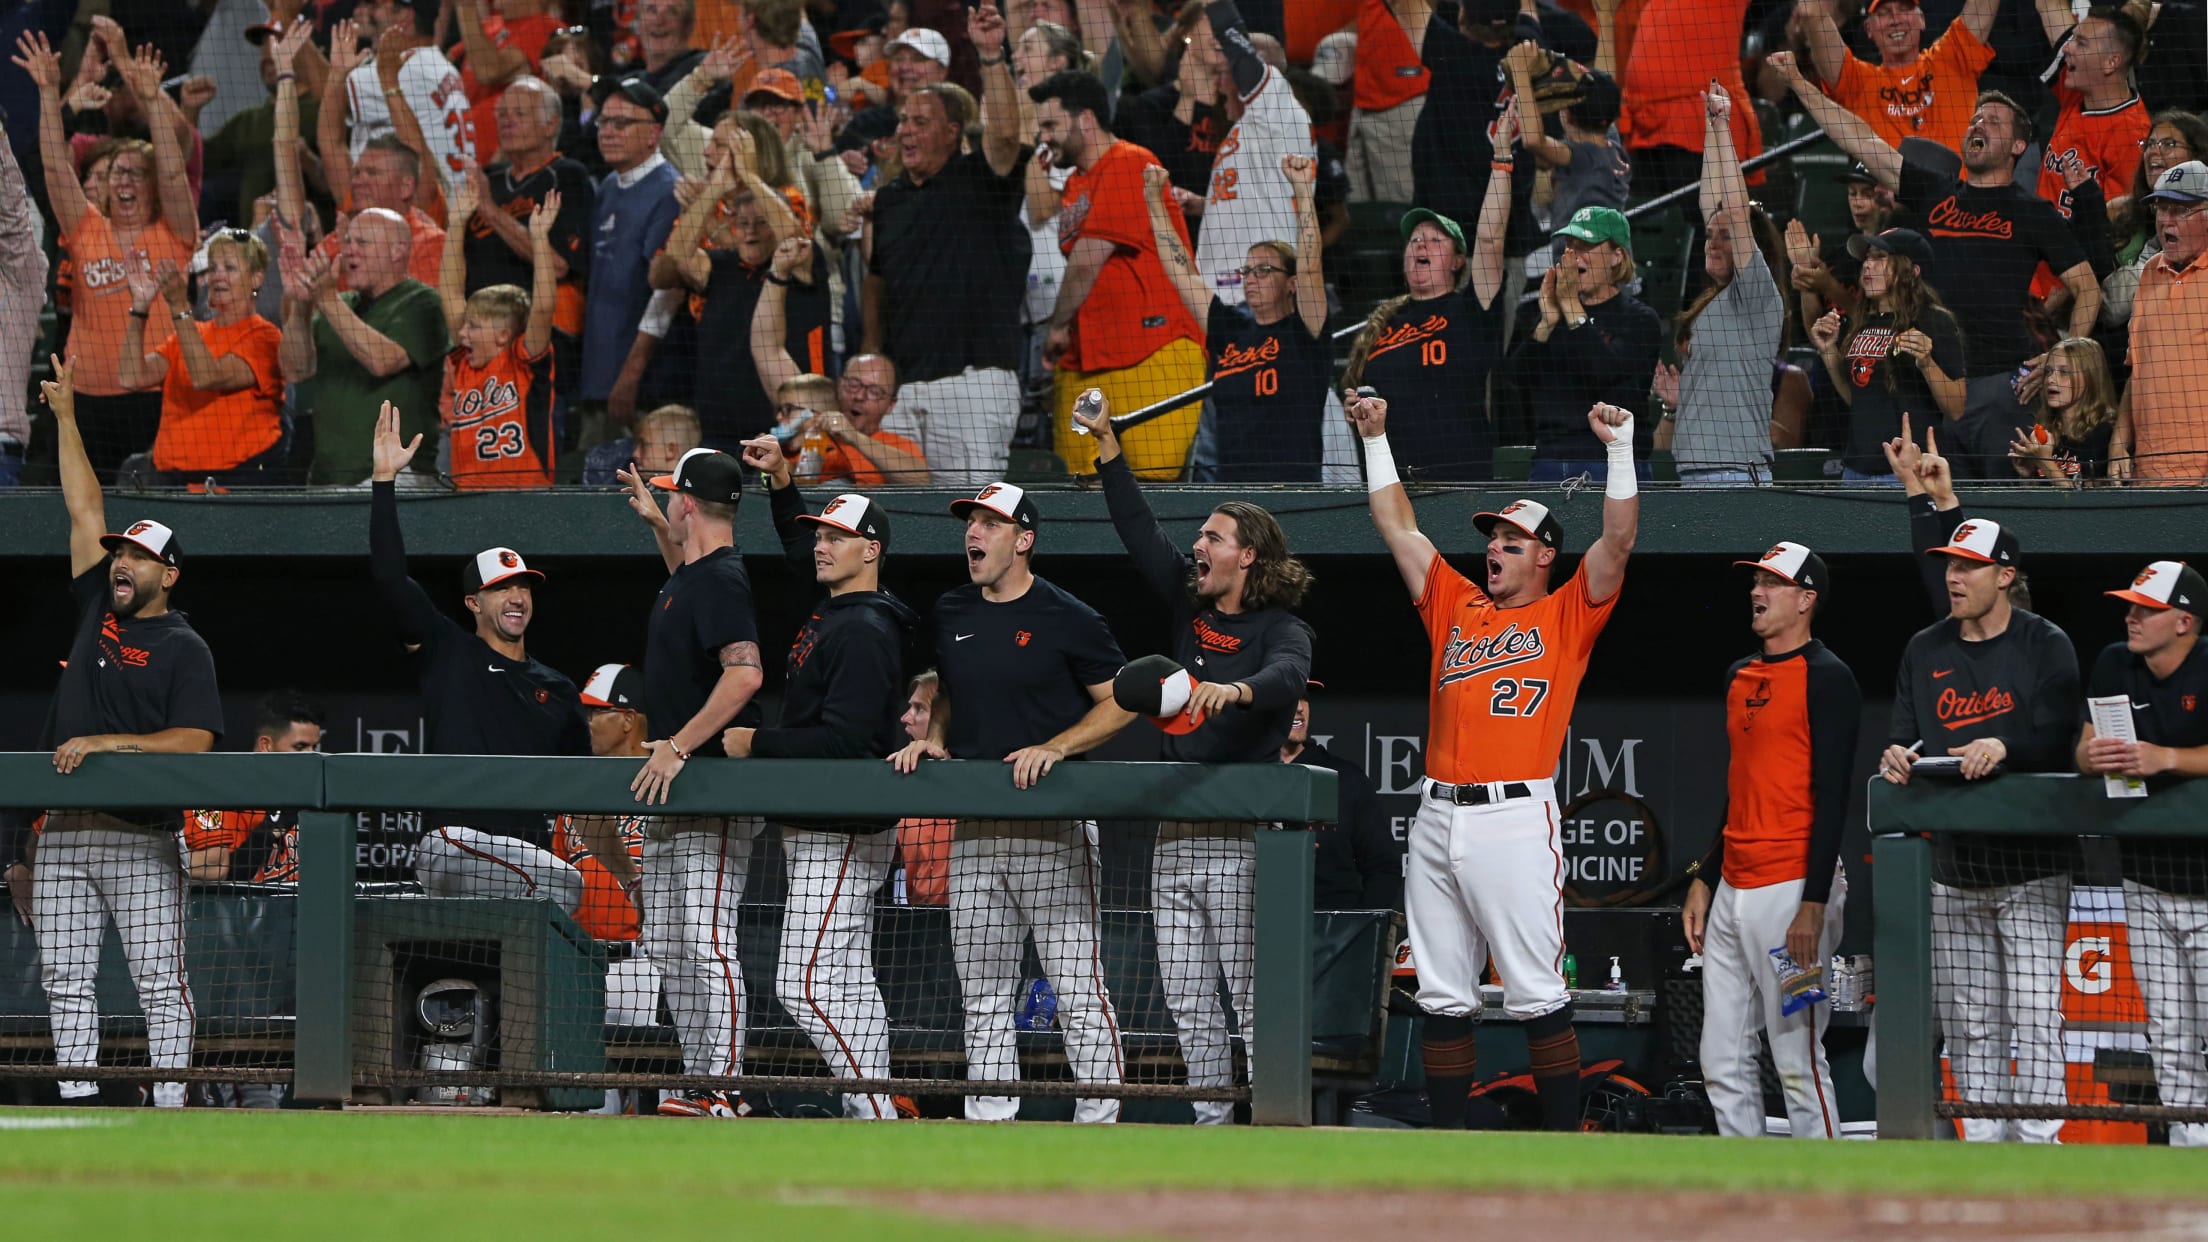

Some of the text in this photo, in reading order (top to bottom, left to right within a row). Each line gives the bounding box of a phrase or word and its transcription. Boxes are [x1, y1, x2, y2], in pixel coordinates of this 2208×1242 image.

[1928, 194, 2013, 240] Orioles
[1421, 339, 1446, 366] 10
[1255, 368, 1278, 397] 10
[476, 421, 524, 461] 23
[1439, 622, 1545, 691] Orioles
[1490, 677, 1549, 717] 27
[1936, 687, 2015, 731] Orioles
[1604, 819, 1644, 845] OF
[2065, 936, 2112, 994] G
